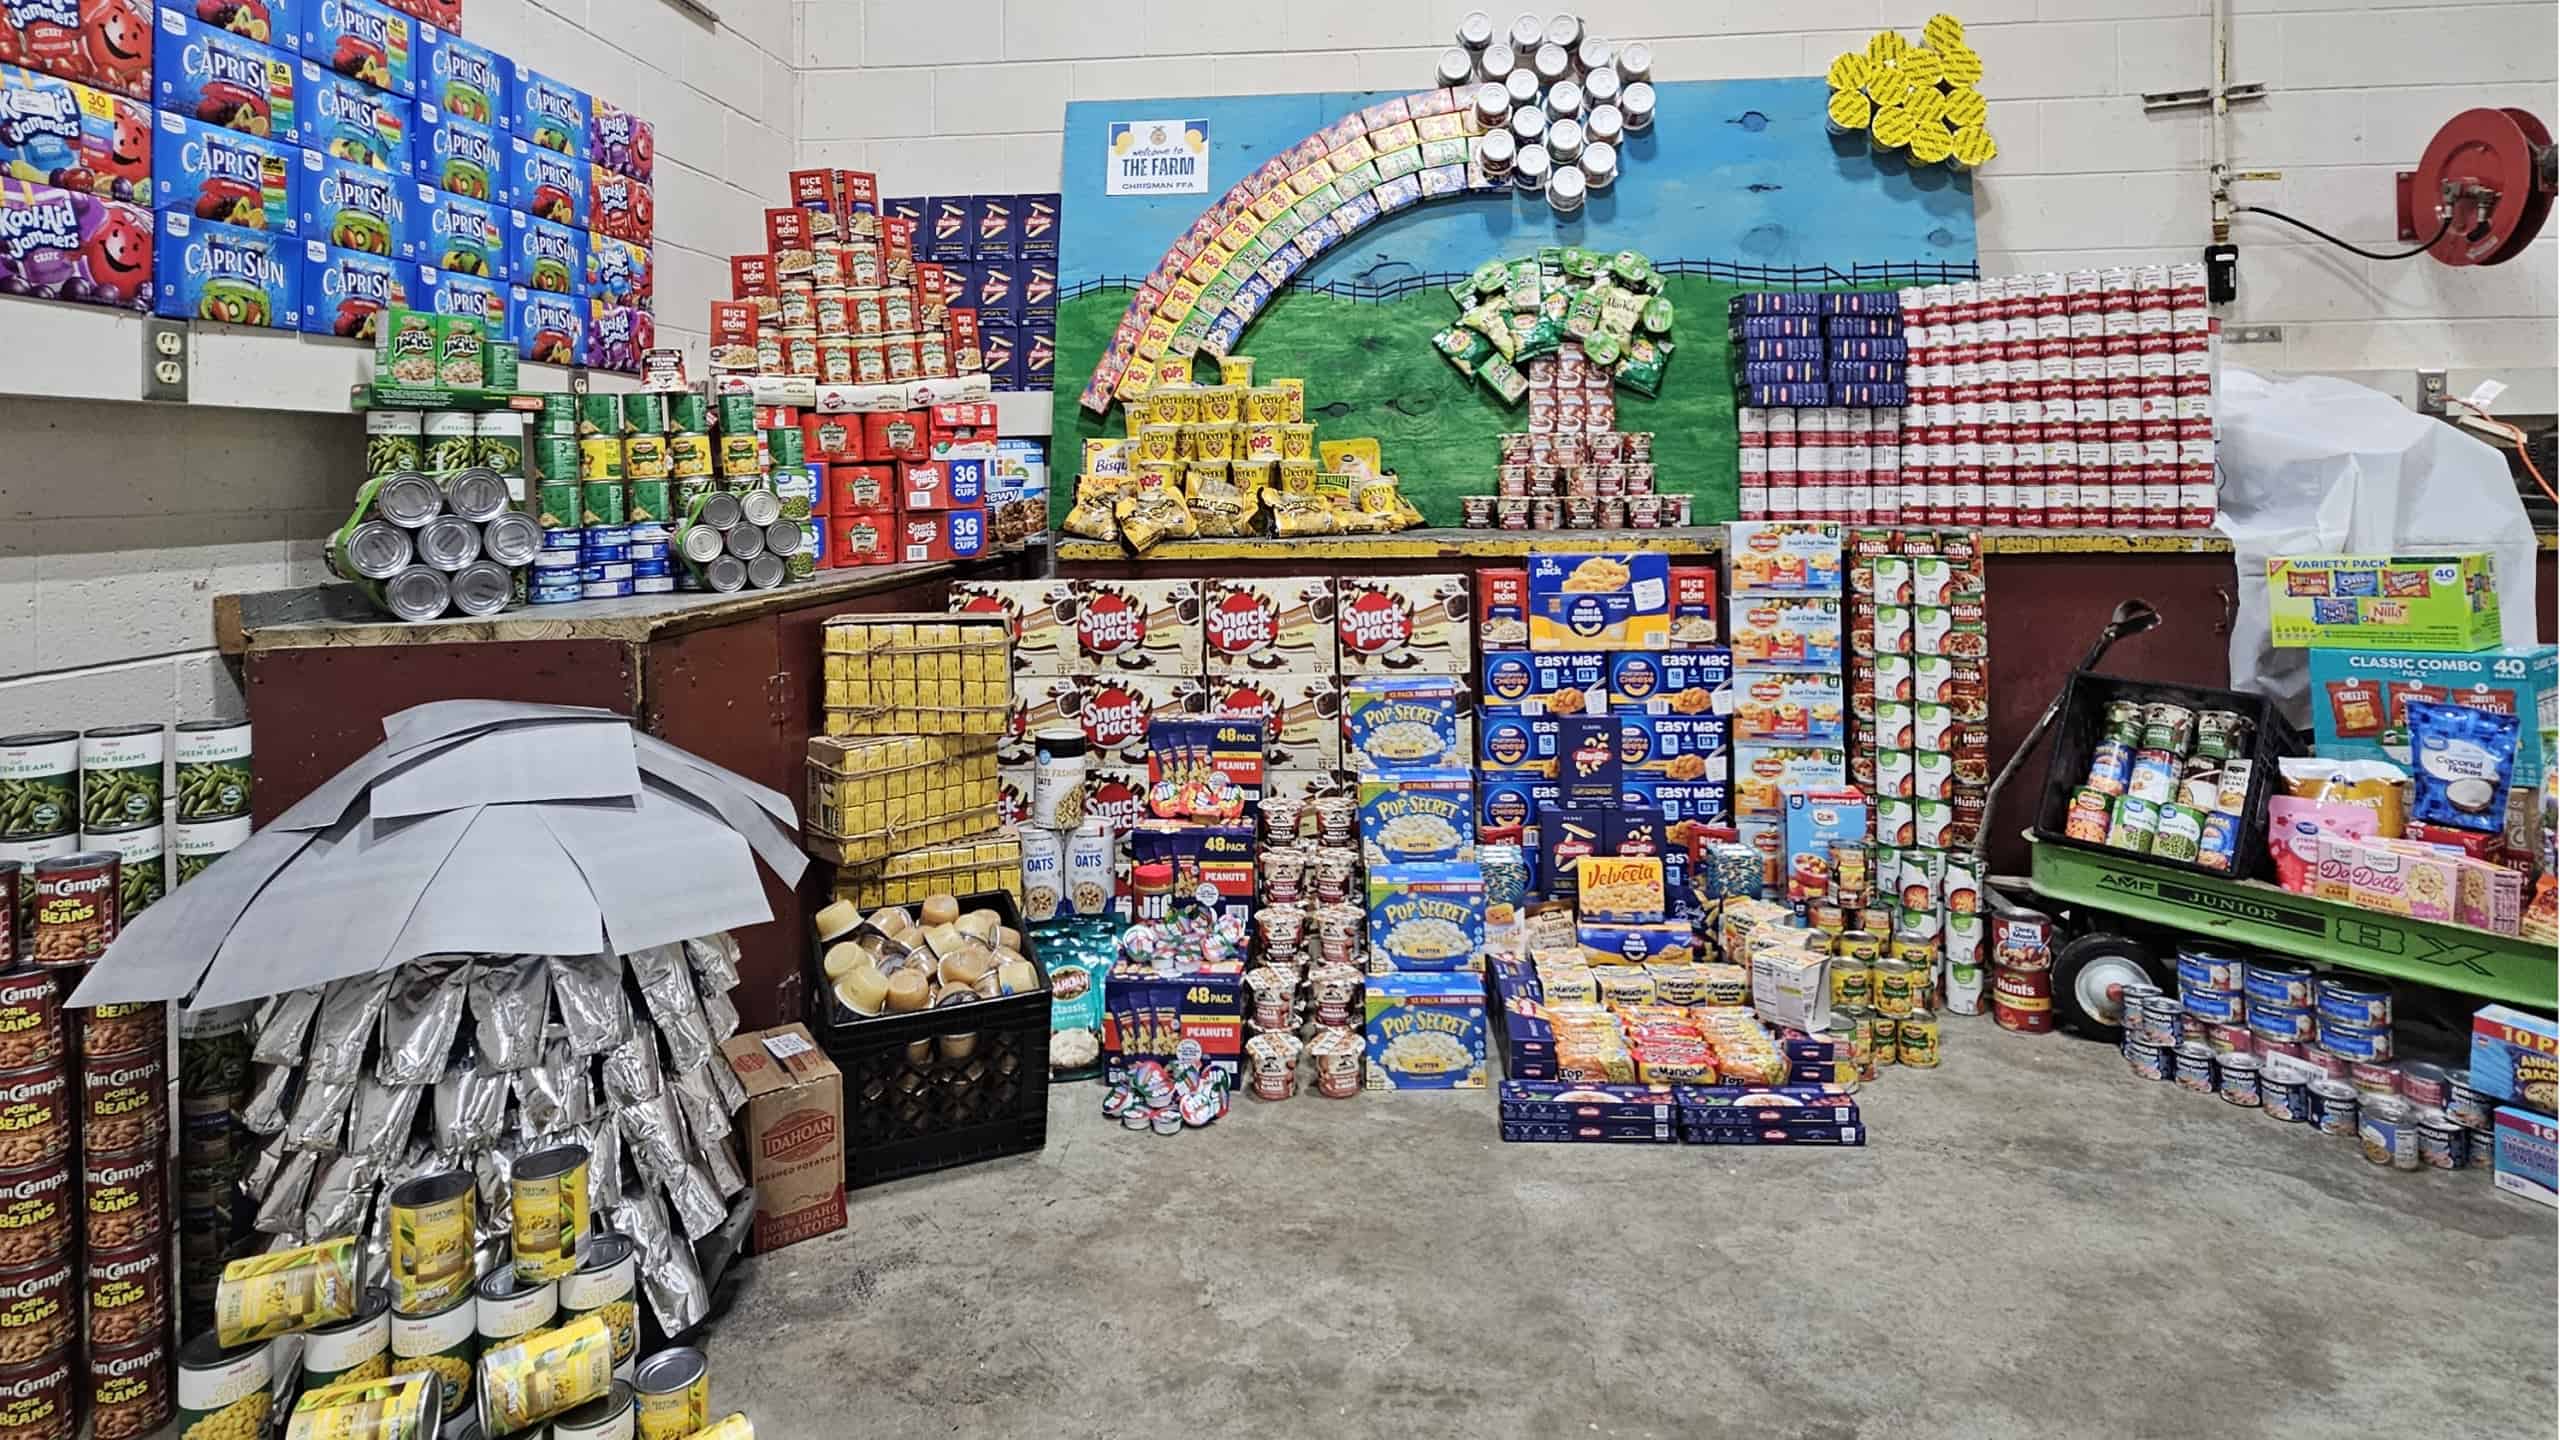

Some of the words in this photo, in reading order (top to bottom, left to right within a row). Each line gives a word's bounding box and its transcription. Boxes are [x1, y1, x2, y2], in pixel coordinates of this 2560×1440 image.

[11, 3, 79, 28] Jammers
[11, 117, 79, 142] Jammers
[1122, 158, 1148, 177] THE
[1152, 156, 1195, 176] FARM
[11, 230, 79, 258] Jammers
[286, 311, 298, 322] 10
[1161, 366, 1186, 383] POPS
[955, 465, 978, 483] 36
[1096, 459, 1127, 475] Bisqu
[955, 487, 977, 497] CUPS
[954, 518, 978, 536] 36
[954, 539, 978, 550] CUPS
[2294, 559, 2348, 569] VARIETY
[2353, 559, 2388, 569] PACK
[2434, 568, 2456, 579] 40
[1493, 580, 1517, 590] RICE
[1680, 579, 1704, 589] RICE
[1079, 607, 1140, 632] Snack
[1209, 604, 1271, 632] Snack
[1343, 603, 1405, 632] Snack
[1092, 624, 1140, 648] pack
[1223, 623, 1271, 648] pack
[1357, 623, 1405, 647] pack
[2350, 656, 2415, 670] CLASSIC
[2418, 658, 2482, 673] COMBO
[2493, 658, 2526, 674] 40
[1083, 701, 1144, 727] Snack
[1394, 703, 1442, 724] SECRET
[1096, 720, 1144, 741] pack
[1216, 727, 1236, 741] 48
[1217, 760, 1256, 771] PEANUTS
[2435, 754, 2484, 769] Coconut
[2447, 765, 2482, 778] Flakes
[1086, 797, 1147, 818] Snack
[1377, 800, 1406, 819] POP
[1409, 795, 1460, 818] SECRET
[1204, 836, 1225, 852] 48
[1226, 842, 1247, 852] PACK
[1027, 856, 1054, 873] OATS
[1075, 854, 1101, 868] OATS
[55, 874, 110, 896] Camp's
[1205, 871, 1247, 882] PEANUTS
[1588, 863, 1655, 889] Velveeta
[2100, 871, 2155, 893] AMF
[2352, 866, 2405, 894] Dolly
[40, 904, 95, 925] BEANS
[49, 898, 81, 910] PORK
[1384, 903, 1415, 924] POP
[1418, 899, 1471, 923] SECRET
[2187, 892, 2279, 922] JUNIOR
[1187, 986, 1210, 1004] 48
[1211, 993, 1233, 1004] PACK
[1186, 1026, 1233, 1039] PEANUTS
[1380, 1018, 1413, 1038] POP
[1416, 1011, 1471, 1036] SECRET
[2501, 1026, 2531, 1047] 10
[85, 1070, 110, 1090] Van
[110, 1059, 161, 1087] Camp's
[95, 1092, 149, 1115] BEANS
[104, 1087, 137, 1101] PORK
[767, 1117, 834, 1155] IDAHOAN
[2530, 1123, 2556, 1141] 16
[757, 1167, 795, 1183] MASHED
[797, 1152, 841, 1171] POTATOES
[14, 1169, 69, 1200] Camp's
[90, 1191, 140, 1213] BEANS
[799, 1202, 840, 1223] IDAHO
[763, 1214, 841, 1249] POTATOES
[105, 1252, 159, 1281] Camp's
[17, 1265, 72, 1298] Camp's
[11, 1296, 46, 1313] PORK
[94, 1285, 145, 1308] BEANS
[1, 1300, 59, 1328] BEANS
[13, 1365, 69, 1398] Camp's
[96, 1380, 148, 1403] BEANS
[104, 1377, 135, 1391] PORK
